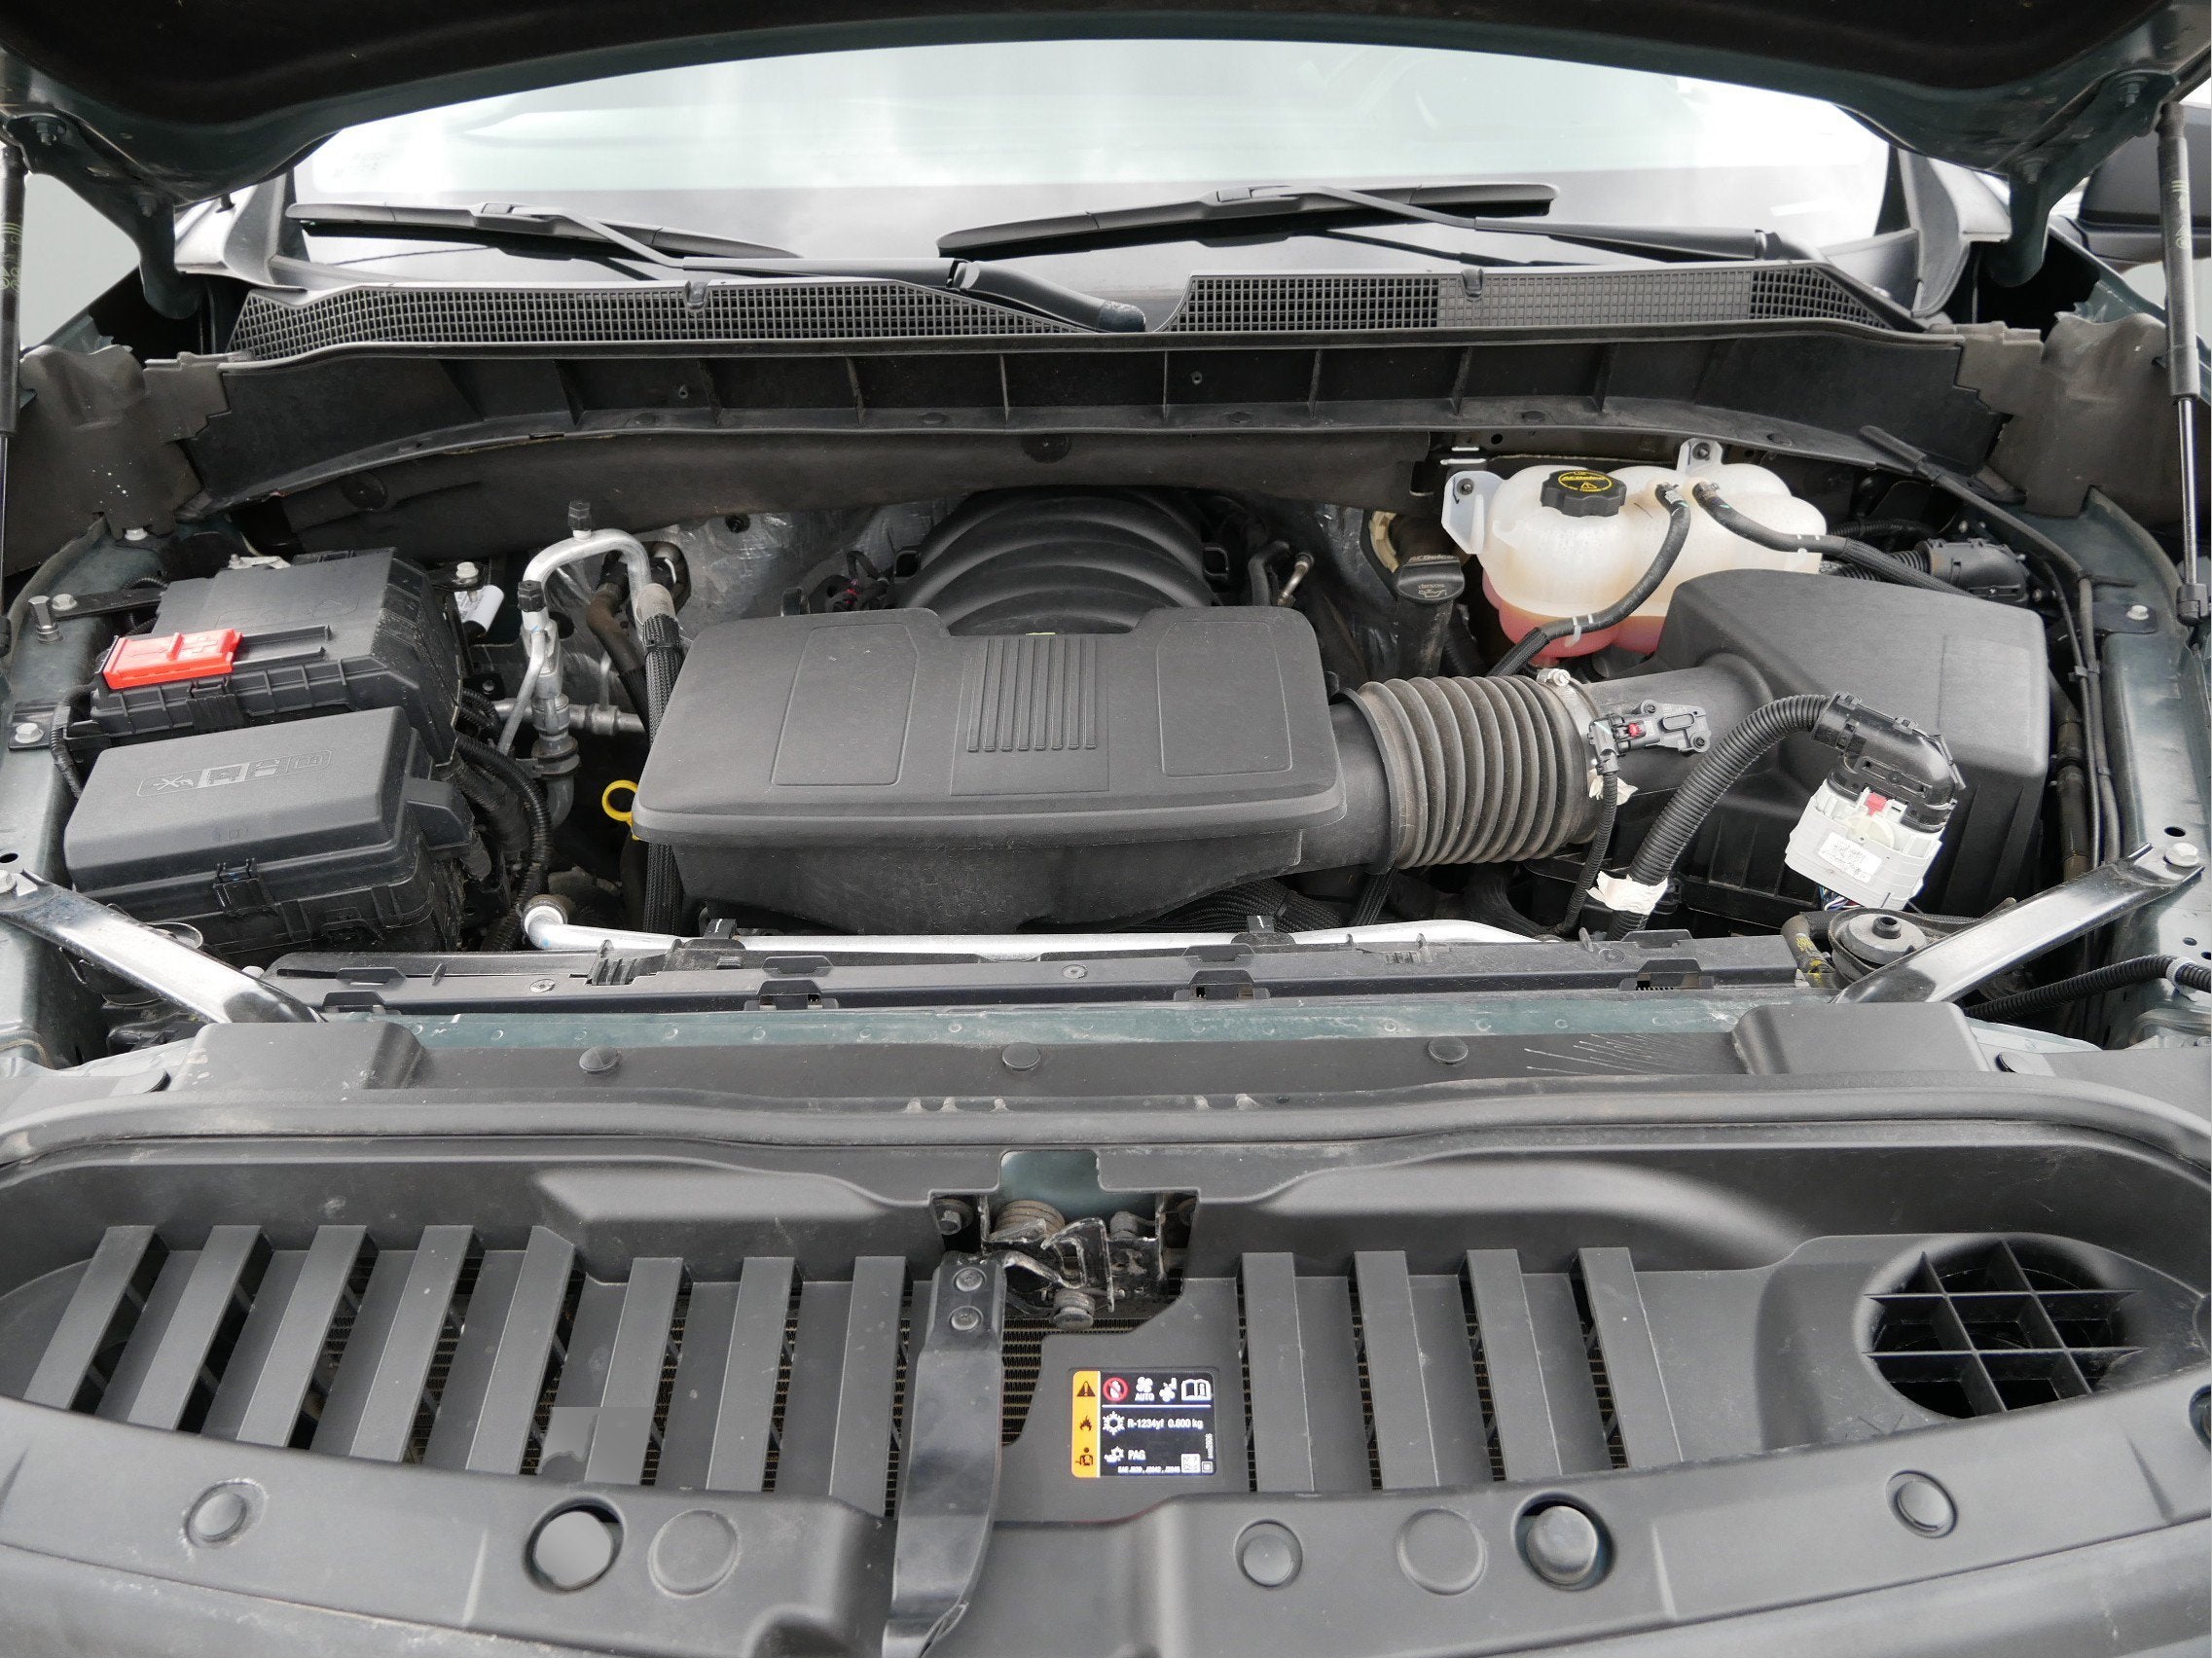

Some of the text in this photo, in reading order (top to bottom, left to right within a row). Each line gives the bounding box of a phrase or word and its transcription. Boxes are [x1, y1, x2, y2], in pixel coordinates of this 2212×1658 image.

[1134, 1392, 1155, 1402] AUTO
[1127, 1418, 1165, 1430] R-1234yf
[1192, 1418, 1204, 1430] kg
[1127, 1449, 1146, 1460] PAG
